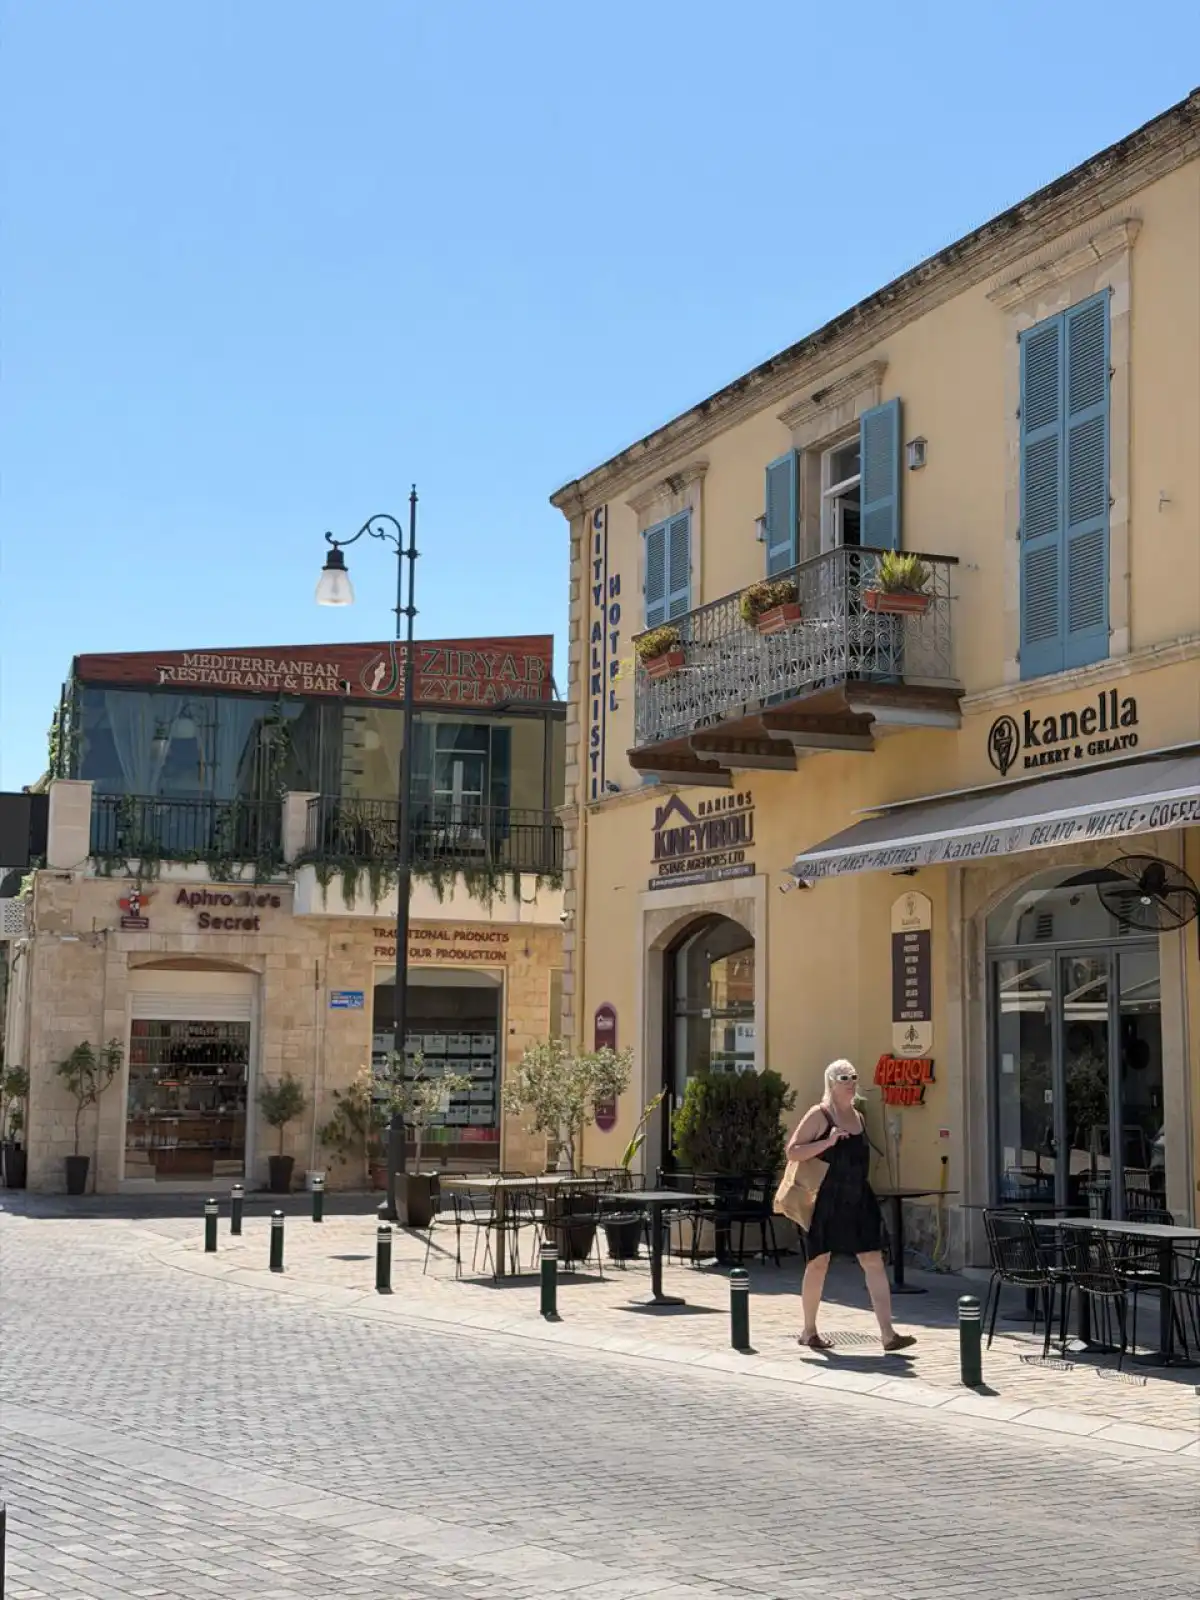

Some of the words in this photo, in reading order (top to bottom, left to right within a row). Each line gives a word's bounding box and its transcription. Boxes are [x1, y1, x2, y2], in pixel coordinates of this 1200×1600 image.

[592, 507, 604, 606] CITY
[609, 574, 621, 712] HOTEL
[161, 665, 282, 688] RESTAURANT
[284, 674, 298, 689] &
[303, 675, 340, 692] BAR
[182, 652, 341, 678] MEDITERRANEAN
[420, 648, 545, 684] ZIRYAB
[589, 621, 602, 800] ALKISTI
[1023, 688, 1140, 749] kanella
[1024, 746, 1071, 769] BAKERY
[1074, 744, 1083, 759] &
[1087, 732, 1139, 756] GELATO
[942, 834, 1001, 860] kanella
[1030, 820, 1077, 846] GELATO
[1085, 808, 1139, 835] WAFFLE
[176, 887, 281, 909] Aphroe's
[197, 911, 261, 932] Secret
[373, 927, 451, 941] TRATIONAL
[453, 929, 510, 944] PRODUCTS
[409, 947, 432, 960] OUR
[435, 948, 507, 962] PRODUCTION
